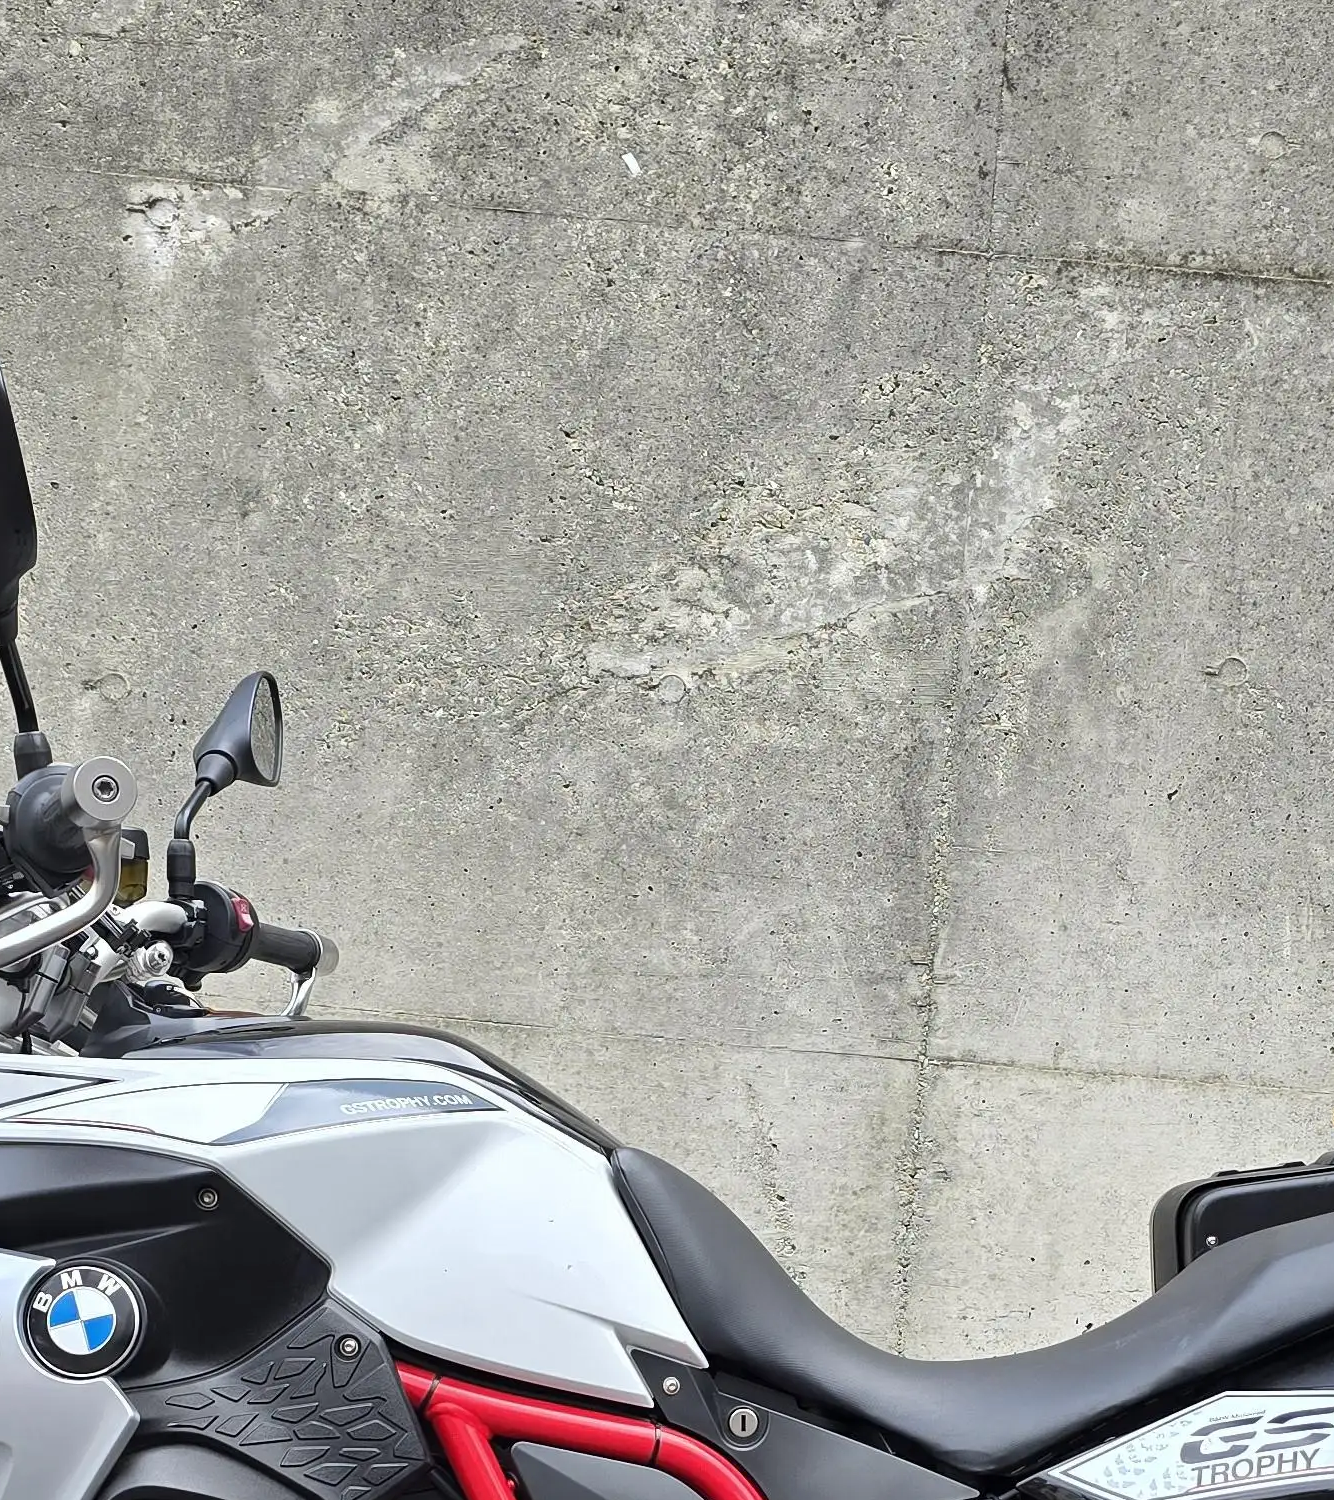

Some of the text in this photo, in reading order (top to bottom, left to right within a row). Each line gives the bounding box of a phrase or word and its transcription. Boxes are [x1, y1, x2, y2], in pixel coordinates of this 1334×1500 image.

[339, 1094, 473, 1115] GSTROPHY.COM
[32, 1269, 125, 1313] BMW
[1191, 1448, 1320, 1488] TROPHY
